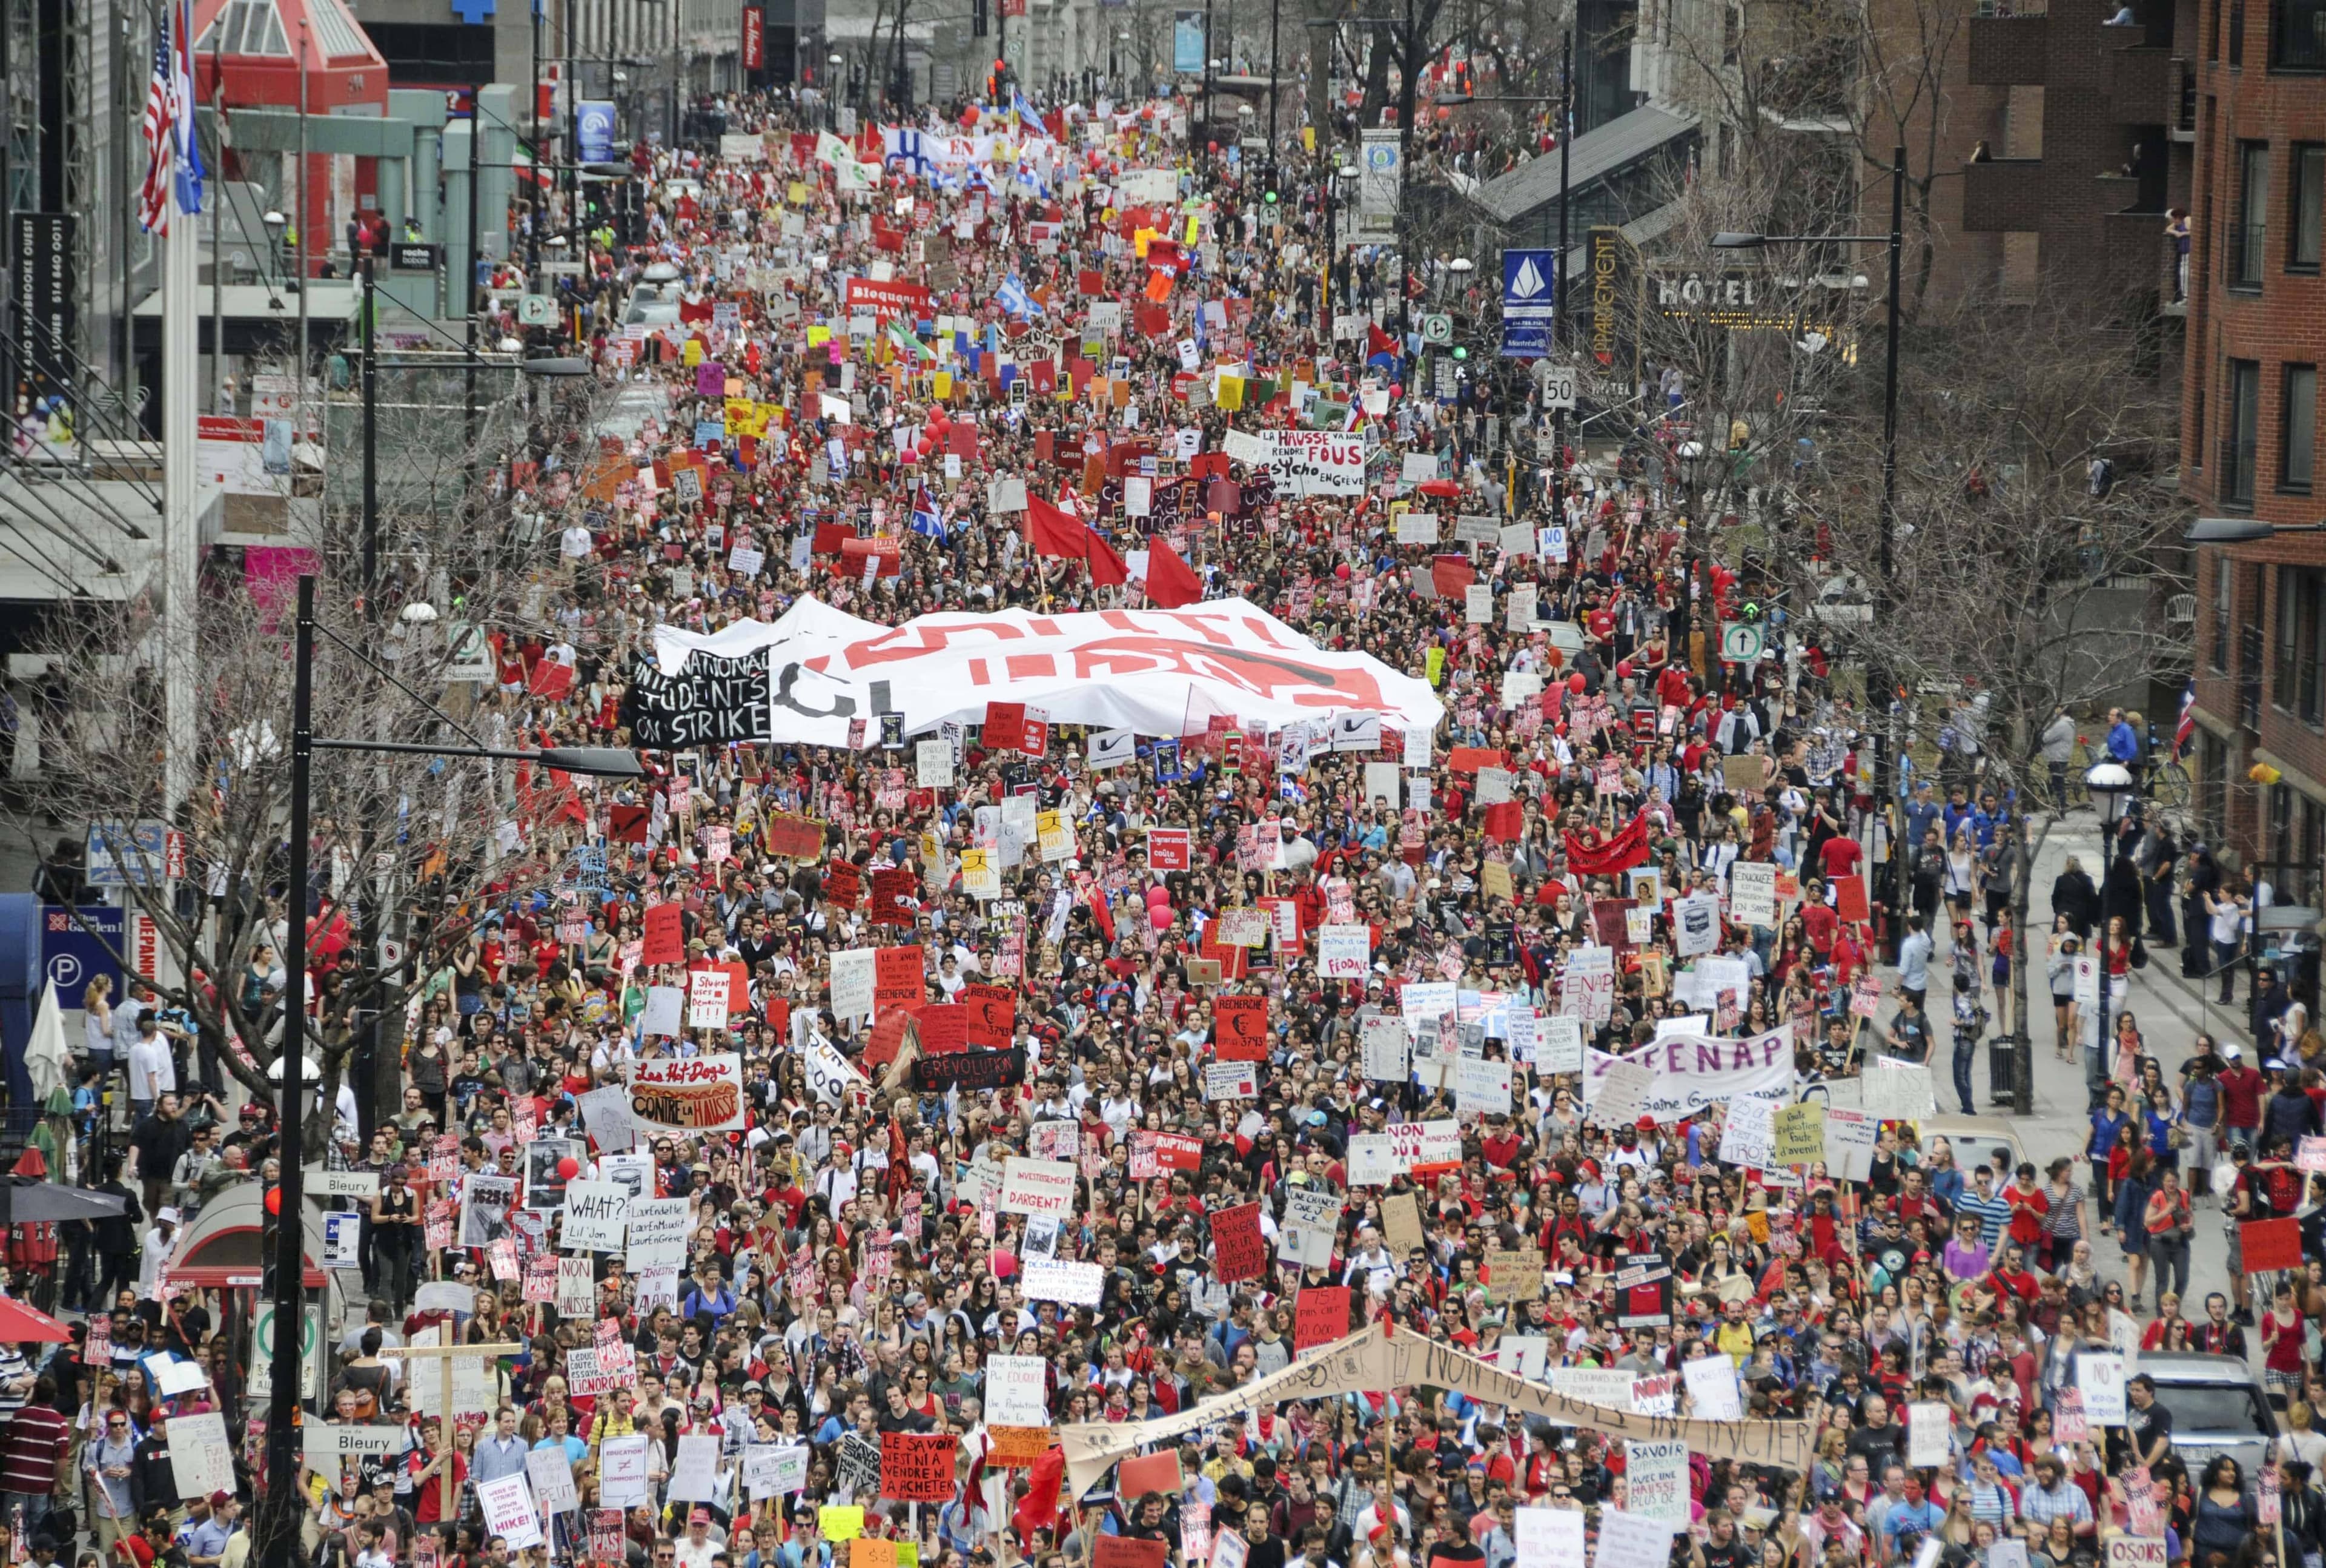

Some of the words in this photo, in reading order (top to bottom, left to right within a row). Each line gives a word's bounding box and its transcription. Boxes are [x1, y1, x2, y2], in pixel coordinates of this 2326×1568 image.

[24, 219, 34, 256] OUEST
[852, 286, 915, 303] Bloquons
[1659, 272, 1754, 305] HÔTEL
[1547, 380, 1571, 400] 50
[1263, 431, 1275, 442] LA
[1277, 431, 1330, 446] HAUSSE
[1346, 432, 1363, 441] NOUS
[1272, 446, 1305, 456] RENDRE
[1308, 445, 1362, 465] FOUS
[1320, 473, 1331, 483] EN
[1545, 528, 1562, 544] NO
[638, 675, 766, 712] STUDENTS
[637, 716, 660, 741] ON
[672, 704, 771, 743] STRIKE
[1153, 849, 1175, 858] coûte
[1734, 902, 1746, 911] EN
[1566, 973, 1613, 994] ENAP
[632, 1096, 684, 1125] CONTRE
[683, 1106, 693, 1116] LA
[692, 1097, 736, 1126] HAUSSE
[1387, 1124, 1425, 1138] NON
[1017, 1171, 1071, 1186] INVESTISSEMENT
[329, 1180, 368, 1193] Bleury
[569, 1194, 626, 1220] WHAT?
[1290, 1191, 1306, 1202] UNE
[1307, 1196, 1336, 1209] CHANCE
[1294, 1203, 1316, 1212] QUE
[328, 1225, 339, 1234] 24
[589, 1226, 606, 1239] Jon
[324, 1245, 338, 1256] 356
[562, 1260, 590, 1278] NON
[1620, 1266, 1645, 1277] POUR
[559, 1297, 594, 1315] HAUSSE
[2093, 1363, 2110, 1384] NO
[1632, 1375, 1671, 1402] NON
[339, 1435, 391, 1452] Bleury
[884, 1437, 900, 1450] LE
[907, 1437, 954, 1452] SAVOIR
[1631, 1444, 1684, 1460] SAVOIR
[884, 1466, 929, 1479] VENDRE
[933, 1467, 944, 1480] NI
[1631, 1473, 1655, 1484] AVEC
[1659, 1471, 1677, 1480] UNE
[900, 1480, 955, 1494] ACHETER
[1632, 1482, 1677, 1495] HAUSSE
[497, 1501, 517, 1510] DOWN
[1631, 1495, 1657, 1507] PLUS
[1660, 1494, 1675, 1504] DE
[494, 1509, 511, 1518] WITH
[512, 1505, 524, 1514] THE
[495, 1514, 531, 1533] HIKE!
[2112, 1542, 2165, 1564] OSONS
